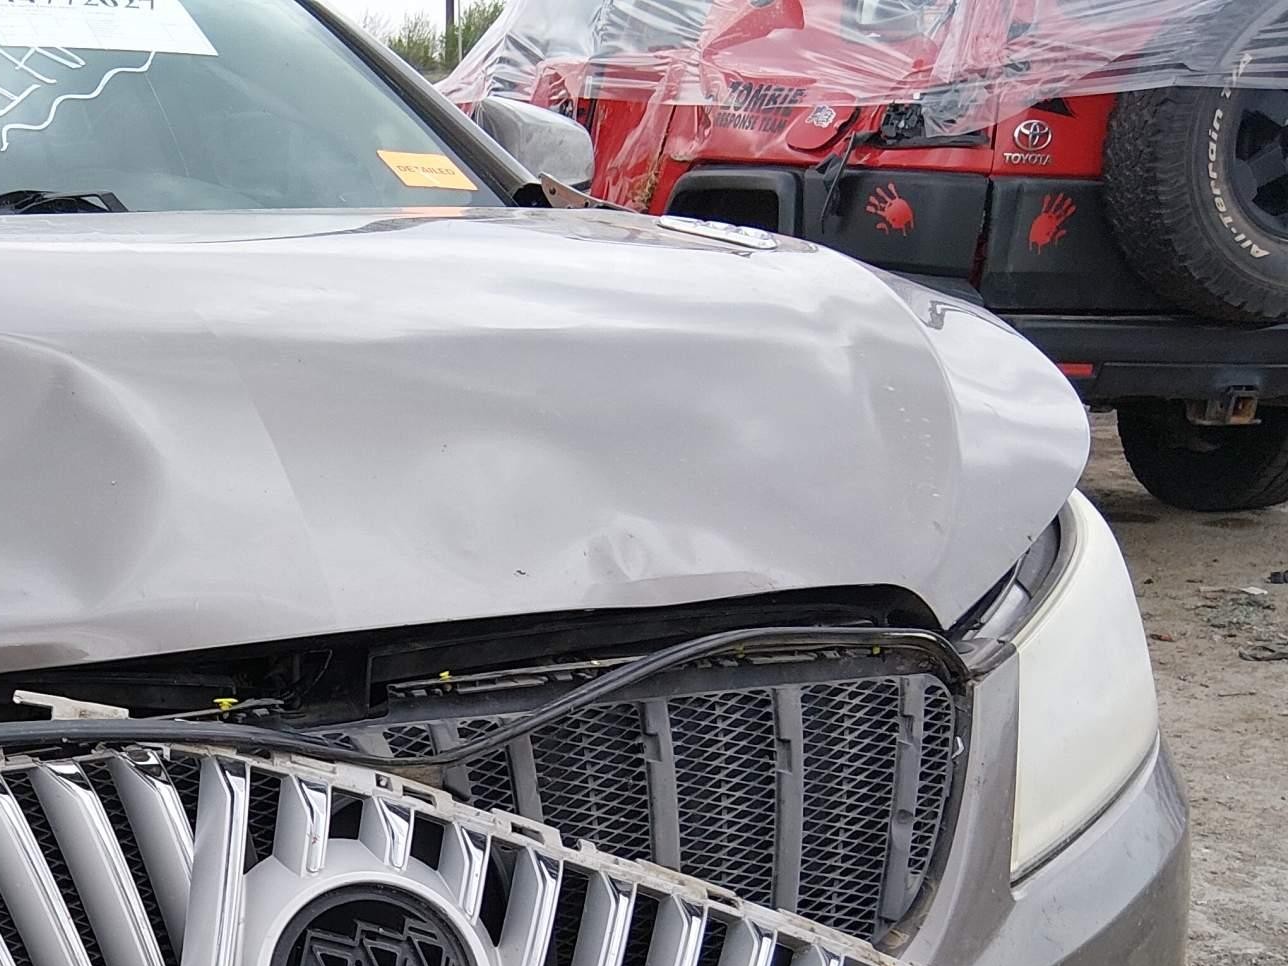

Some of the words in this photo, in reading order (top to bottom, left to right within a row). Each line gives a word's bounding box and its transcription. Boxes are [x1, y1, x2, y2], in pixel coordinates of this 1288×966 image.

[758, 116, 788, 133] TEAM
[1003, 152, 1052, 166] TOYOTA
[396, 165, 455, 175] DETAILED
[1207, 108, 1271, 258] All-Terrain
